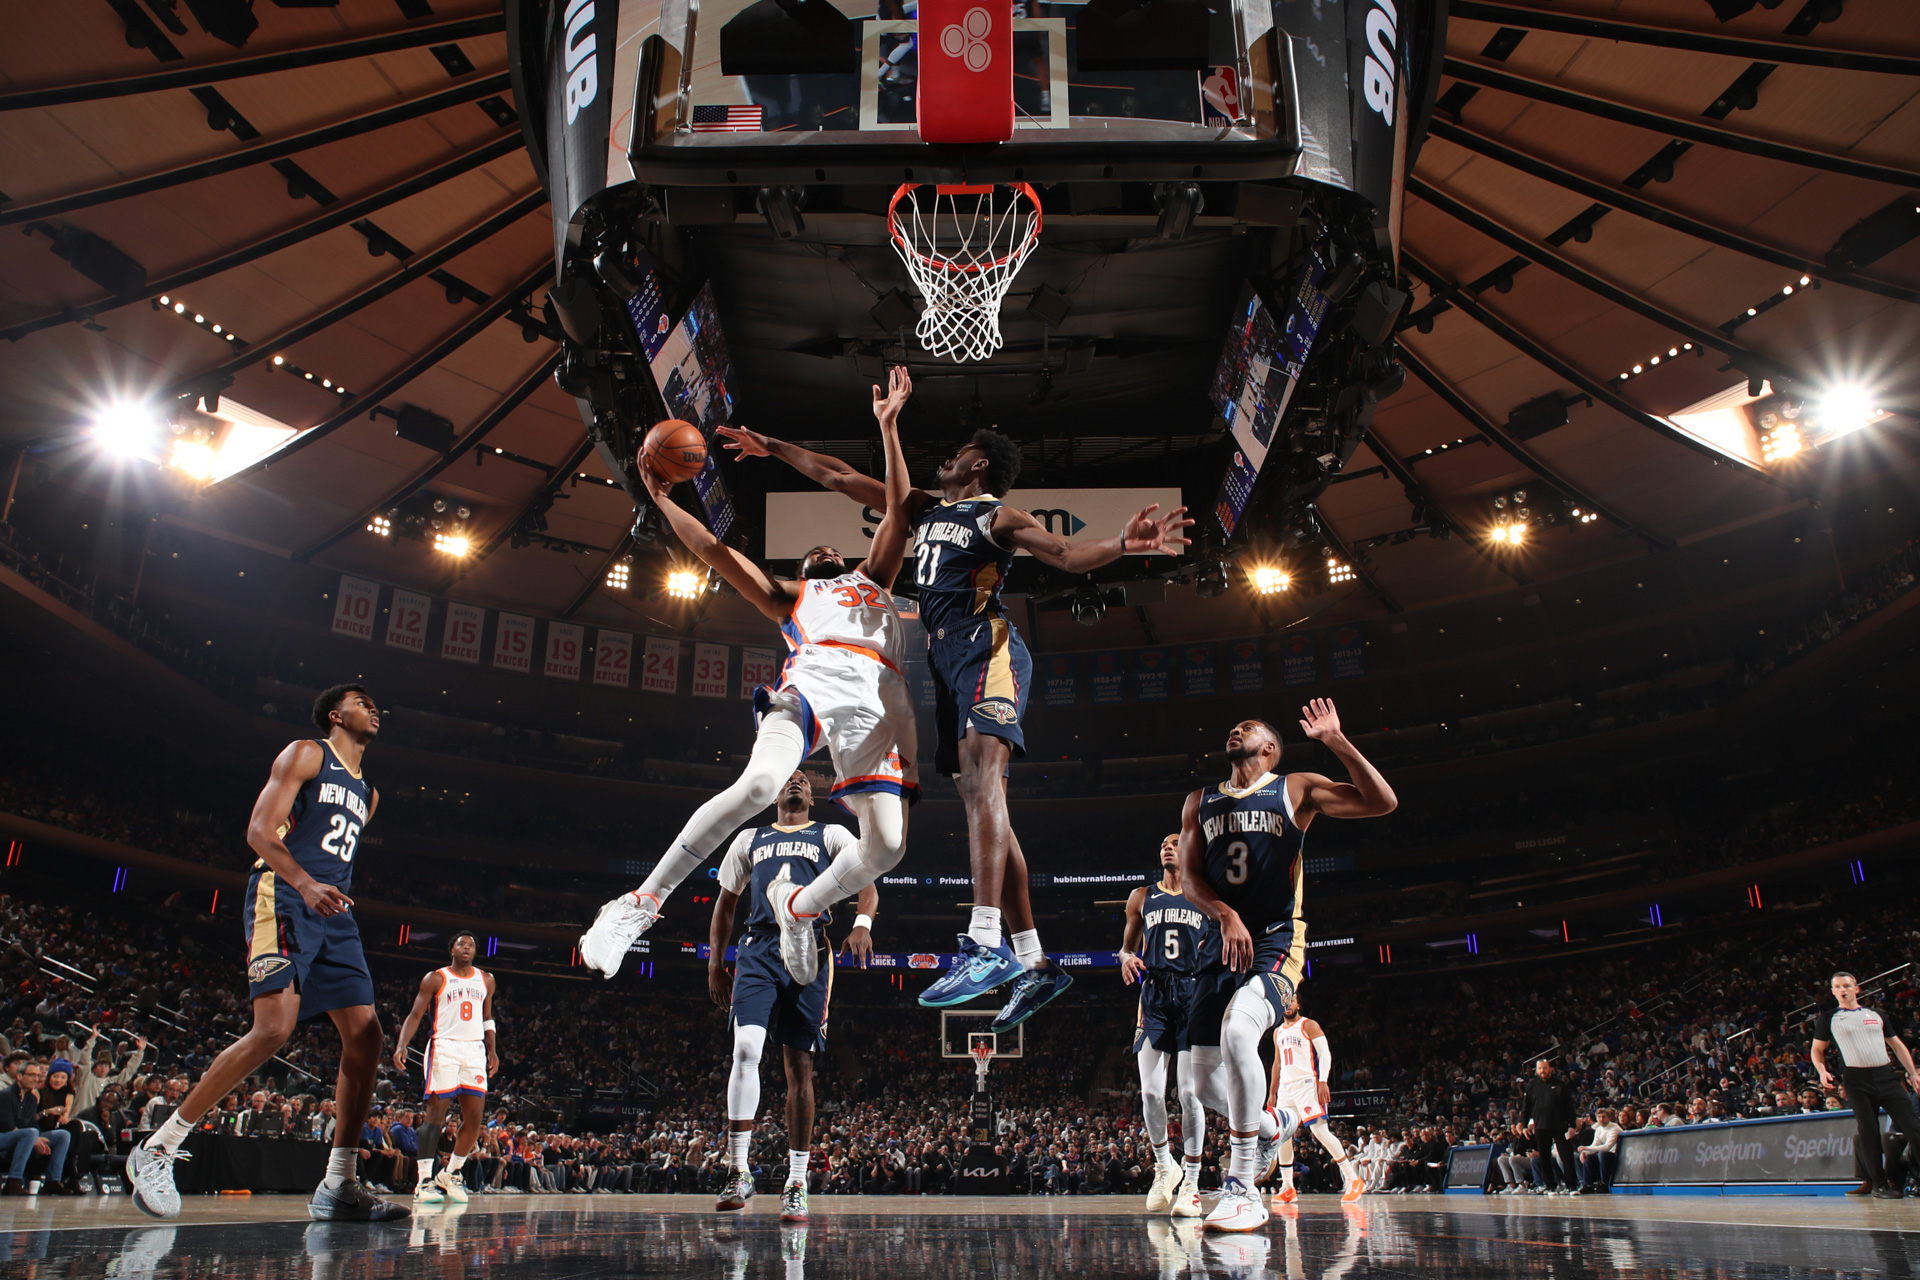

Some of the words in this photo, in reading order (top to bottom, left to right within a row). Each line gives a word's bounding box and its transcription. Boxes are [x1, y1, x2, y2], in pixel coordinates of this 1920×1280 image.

[1208, 116, 1227, 127] NBA
[928, 521, 973, 549] ORLEANS
[917, 543, 942, 586] 21
[813, 578, 844, 595] NEW
[832, 583, 888, 608] 32
[342, 594, 370, 619] 10
[335, 618, 371, 636] KNICKS
[395, 607, 422, 633] 12
[389, 631, 423, 649] KNICKS
[450, 621, 477, 644] 15
[502, 629, 528, 653] 15
[443, 644, 478, 659] KNICKS
[552, 638, 577, 661] 19
[598, 646, 628, 670] 22
[496, 653, 529, 669] KNICKS
[546, 662, 579, 676] KNICKS
[646, 653, 675, 677] 24
[696, 659, 726, 680] 33
[596, 670, 627, 683] KNICKS
[643, 676, 675, 689] KNICKS
[743, 662, 775, 684] 613
[694, 682, 726, 694] KNICKS
[318, 783, 346, 806] NEW
[321, 813, 360, 863] 25
[1203, 814, 1225, 846] NEW
[1228, 810, 1283, 837] ORLEANS
[360, 835, 384, 845] IGHT
[1537, 835, 1567, 846] LIGHT
[752, 842, 776, 867] NEW
[775, 841, 820, 863] ORLEANS
[1226, 841, 1249, 885] 3
[774, 862, 792, 881] 4
[882, 876, 918, 884] Benefits
[1053, 874, 1145, 883] hubinternational.com
[1145, 908, 1164, 930] NEW
[1164, 908, 1202, 929] ORLEANS
[1164, 929, 1179, 960] 5
[1306, 937, 1354, 948] K.COM/NYKNICKS
[870, 958, 896, 966] KNICKS
[1059, 957, 1092, 966] PELICANS
[446, 988, 464, 1004] NEW
[460, 1001, 473, 1021] 8
[1283, 1047, 1293, 1065] 11
[621, 1106, 647, 1115] ULTRA
[1353, 1096, 1387, 1106] ULTRA
[1625, 1147, 1678, 1168] Spectrum
[1697, 1141, 1762, 1167] Spectrum
[1784, 1133, 1853, 1164] Spectru
[963, 1167, 999, 1177] KIA
[1451, 1157, 1486, 1178] Spectrum
